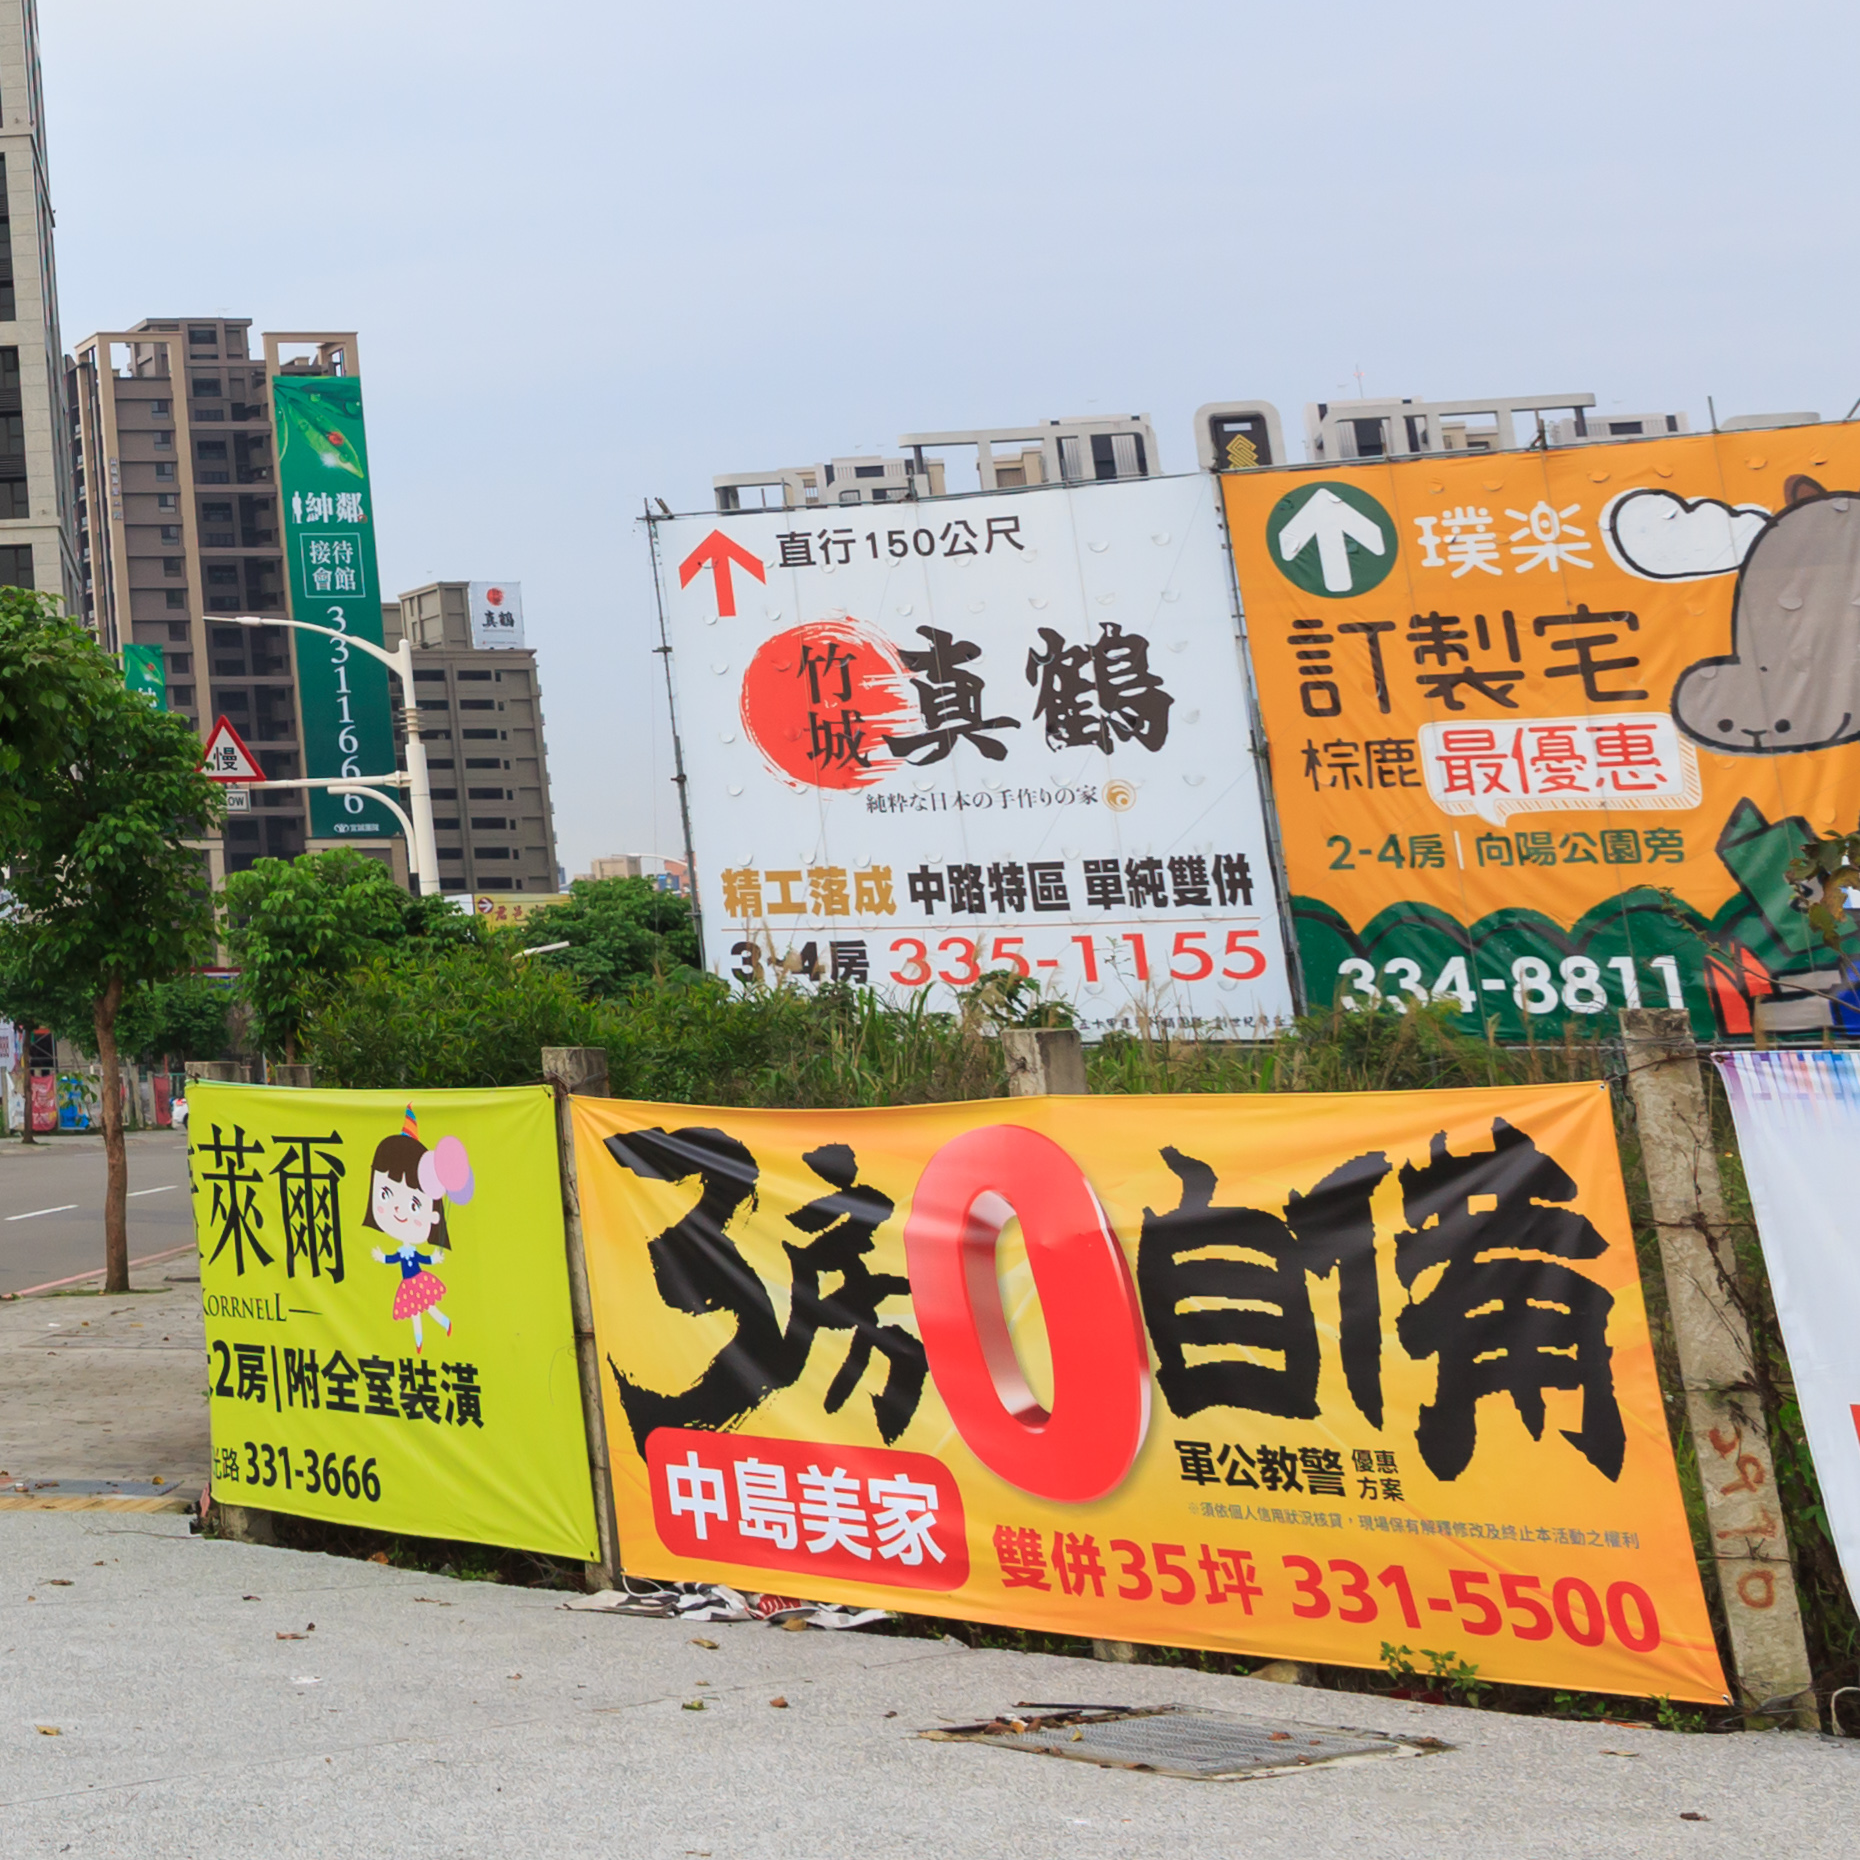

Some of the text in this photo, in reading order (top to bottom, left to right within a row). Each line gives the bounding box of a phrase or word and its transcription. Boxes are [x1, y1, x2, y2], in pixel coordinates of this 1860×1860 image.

[308, 541, 355, 566] 接待
[775, 516, 1025, 568] 直行150公尺
[312, 566, 357, 593] 會館
[1286, 603, 1650, 718] 訂製宅
[796, 642, 873, 772] 竹城
[881, 622, 1176, 766] 真鶴
[213, 746, 238, 771] 慢
[1301, 722, 1669, 796] 棕鹿 最優惠
[1327, 826, 1687, 871] 2-4房 向陽公園旁
[720, 852, 1255, 918] 精工落成 中路特區 單純雙併
[888, 928, 1268, 987] 335-1155
[1336, 954, 1688, 1014] 334-8811
[284, 1346, 485, 1430] 附全室裝潢
[244, 1441, 382, 1503] 331-3666
[1174, 1439, 1397, 1497] 軍公教警 優惠
[1356, 1476, 1405, 1504] 方案
[665, 1449, 947, 1566] 中島美家
[993, 1523, 1662, 1655] 雙併35坪 331-5500
